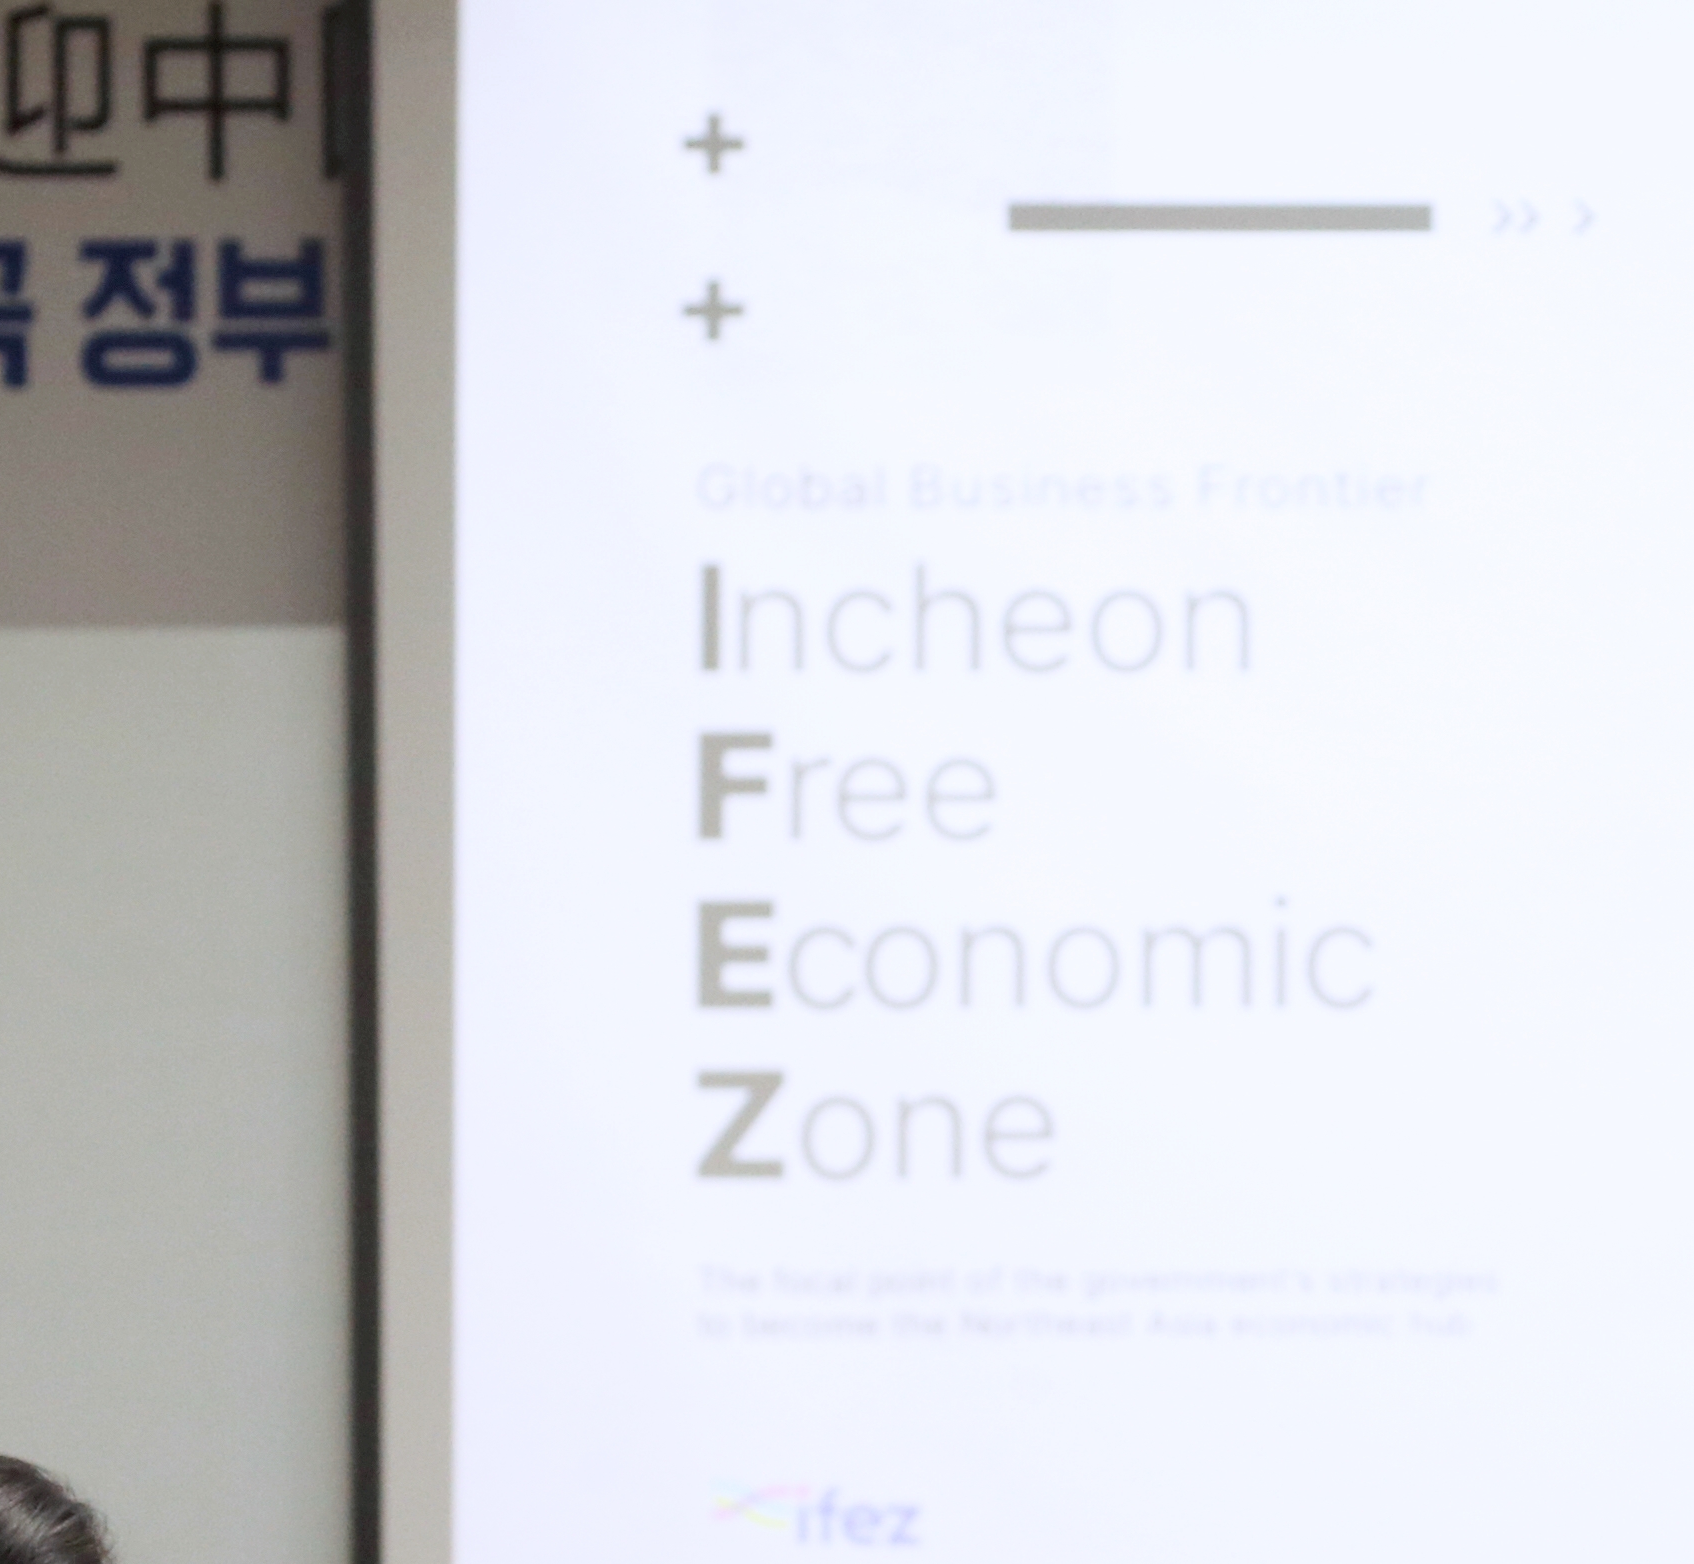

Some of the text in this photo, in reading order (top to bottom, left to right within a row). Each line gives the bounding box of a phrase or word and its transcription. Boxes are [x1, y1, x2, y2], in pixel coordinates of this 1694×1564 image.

[78, 237, 332, 390] 정부
[695, 461, 1431, 513] Global Business Frontier
[699, 562, 1254, 676] Incheon
[695, 730, 997, 843] Free
[695, 896, 1375, 1012] Economic
[695, 1069, 1057, 1183] Zone
[696, 1311, 733, 1340] to
[891, 1309, 948, 1340] the
[698, 1264, 762, 1296] The
[965, 1264, 1004, 1296] of
[1013, 1264, 1070, 1296] the
[795, 1484, 923, 1548] ifez
